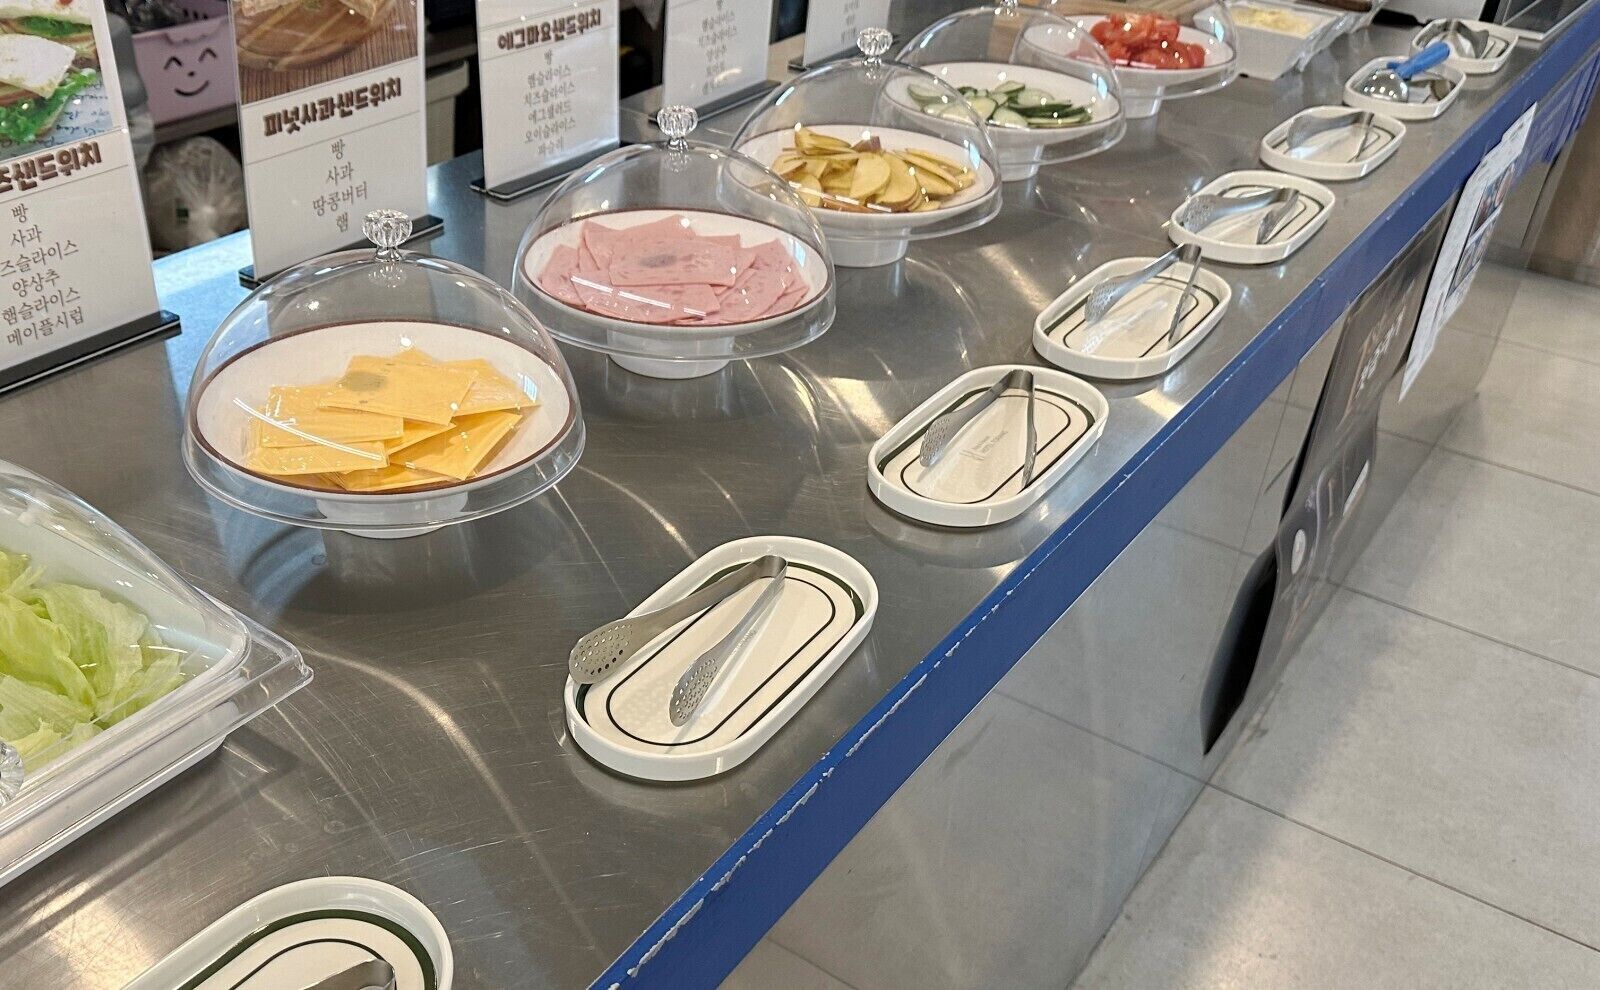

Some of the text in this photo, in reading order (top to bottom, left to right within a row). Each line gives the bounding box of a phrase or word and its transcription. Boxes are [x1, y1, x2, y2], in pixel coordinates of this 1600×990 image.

[497, 8, 601, 50] 에그마요샌드위치
[527, 64, 572, 89] 햄슬라이스
[263, 77, 402, 137] 피넛사과샌드위치
[523, 81, 575, 107] 치즈슬라이스
[528, 101, 572, 124] 에그샐러드
[525, 117, 576, 144] 오이슬라이스
[331, 139, 346, 160] 빵
[325, 162, 354, 187] 사과
[312, 180, 368, 217] 땅콩버터
[11, 203, 29, 224] 빵
[336, 212, 349, 233] 햄
[11, 225, 43, 248] 사과
[0, 239, 79, 277] 즈슬라이스
[12, 268, 61, 298] 양상추
[2, 287, 81, 326] 햄슬라이스
[6, 306, 85, 347] 메이플시럽
